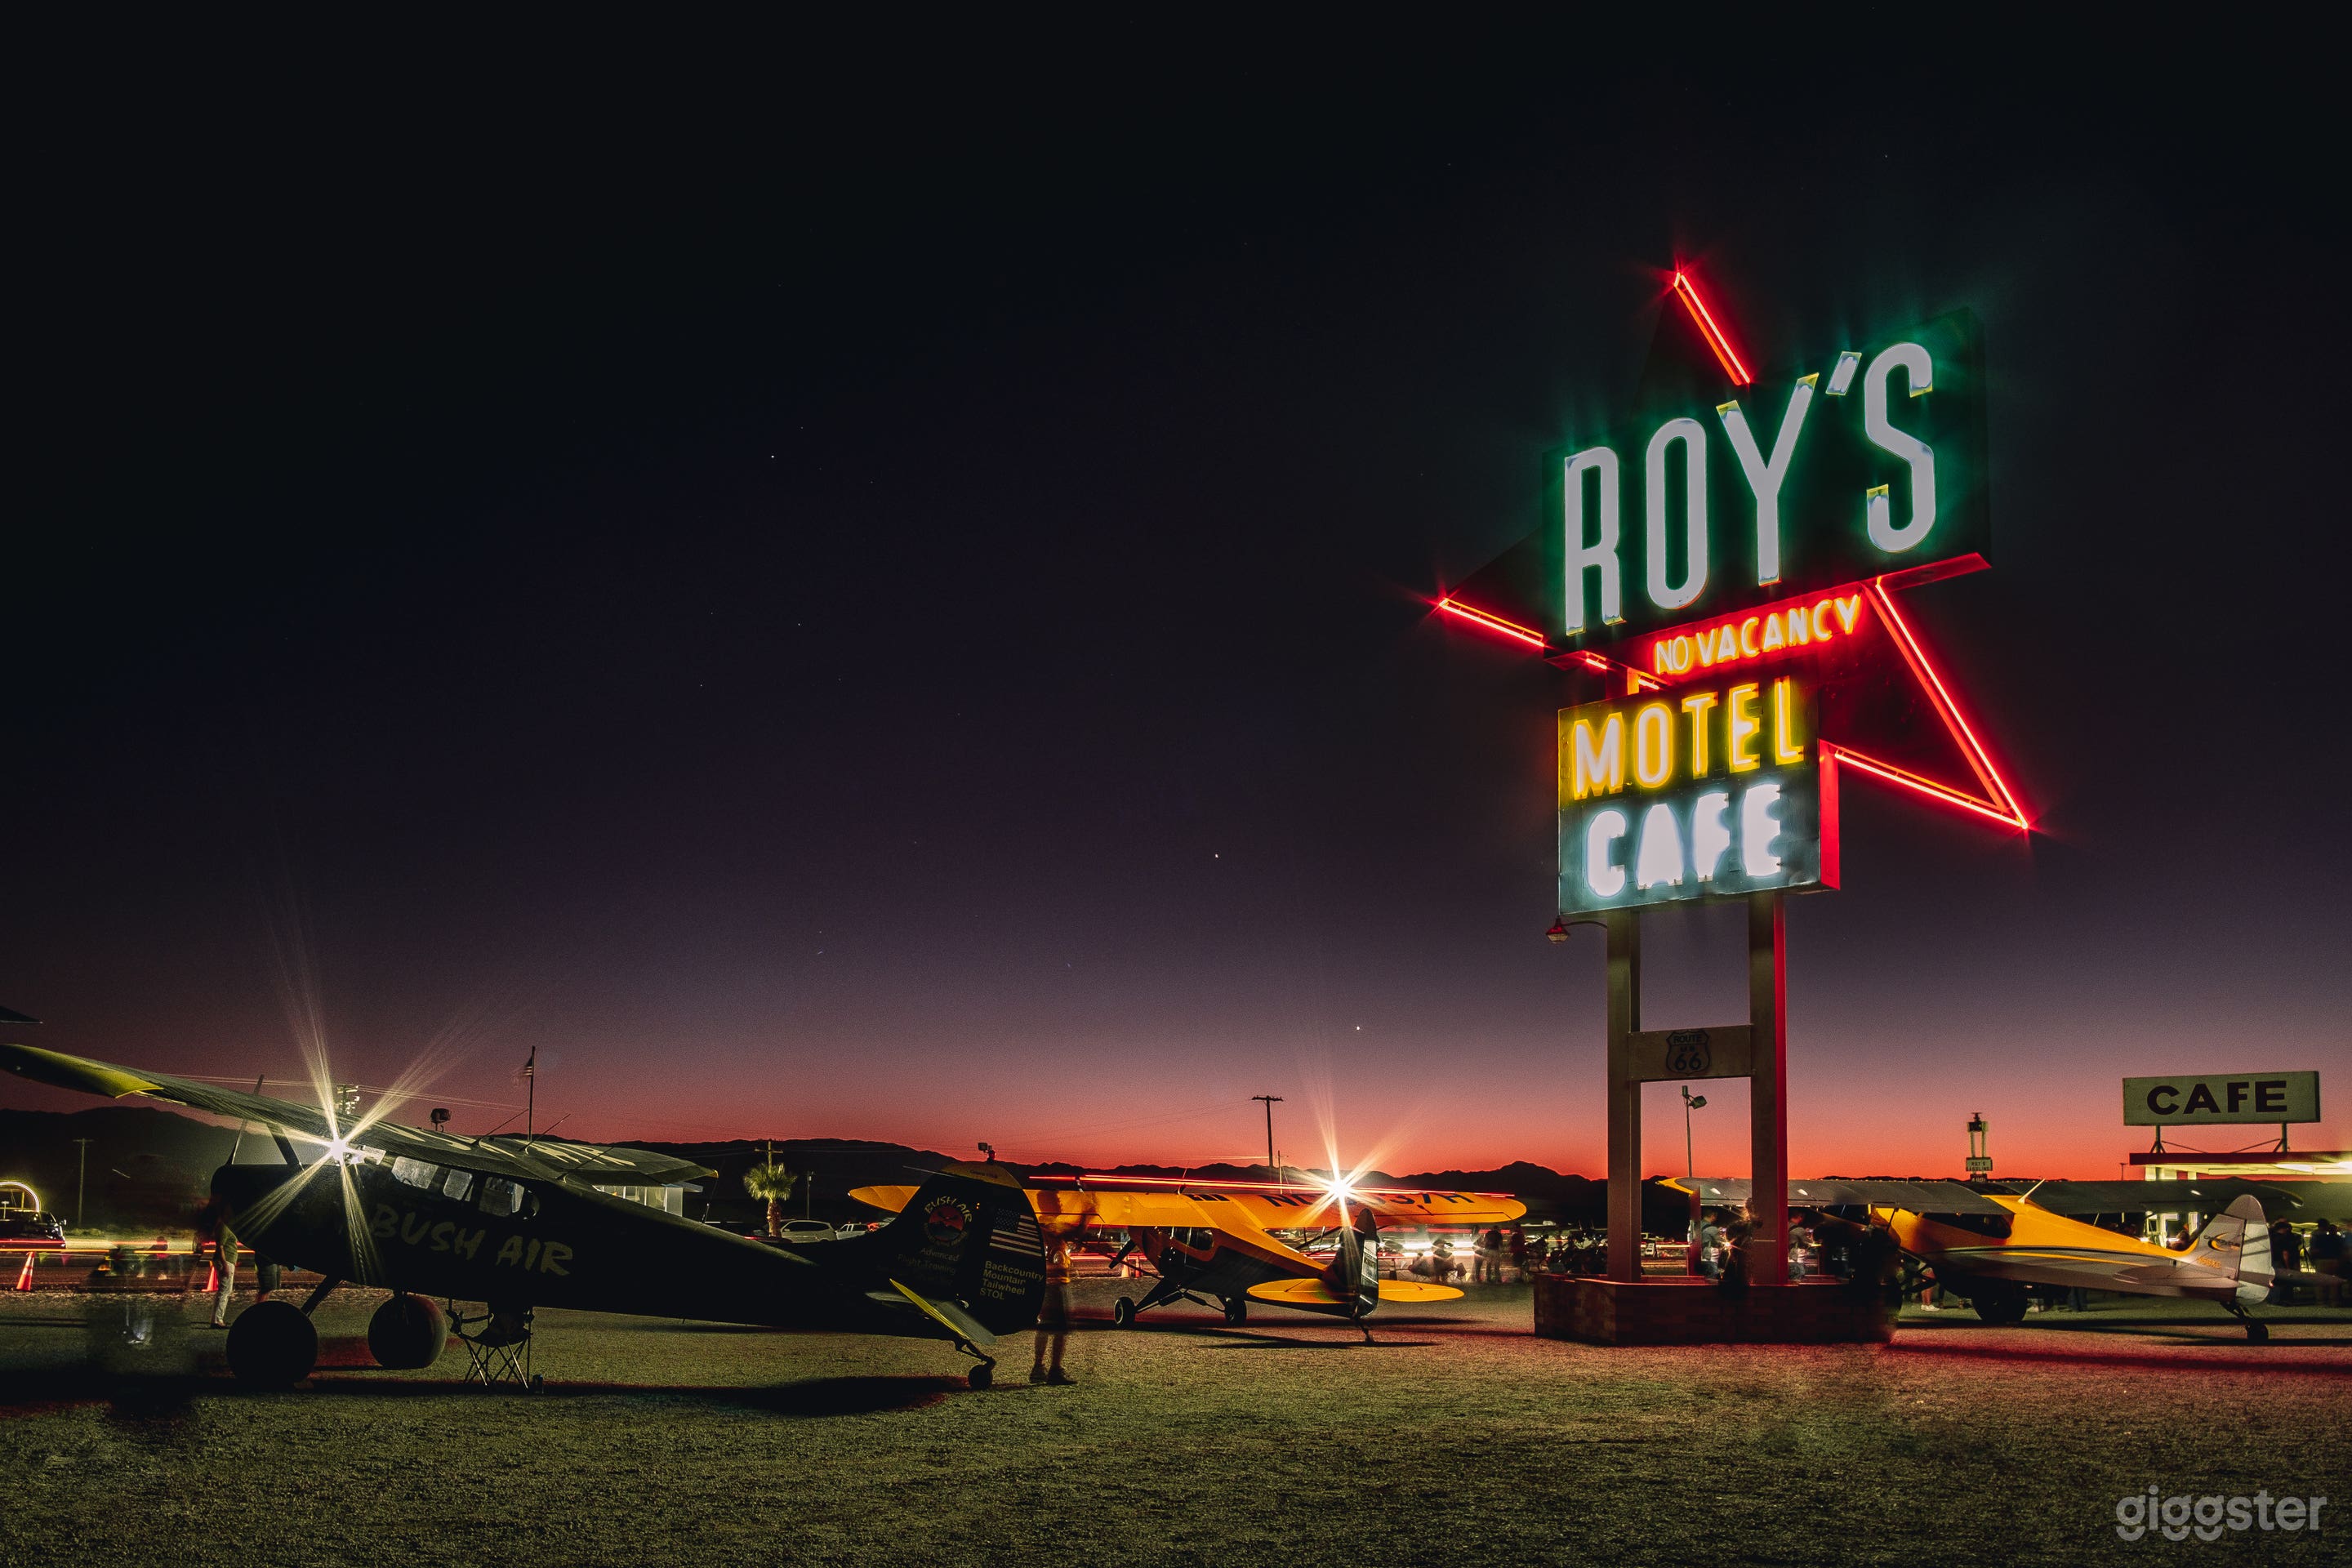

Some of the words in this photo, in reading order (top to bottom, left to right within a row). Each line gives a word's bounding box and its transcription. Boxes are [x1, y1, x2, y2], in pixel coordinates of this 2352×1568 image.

[1564, 342, 1936, 636] ROY'S
[1654, 636, 1692, 675] NO
[1695, 595, 1860, 666] VACANCY
[1572, 675, 1805, 800] MOTEL
[1586, 783, 1782, 898] CAFE
[1673, 1034, 1703, 1044] ROUTE
[1675, 1052, 1701, 1071] 66
[2147, 1081, 2287, 1116] CAFE
[924, 1196, 957, 1214] BUSH
[956, 1202, 973, 1224] AIR
[369, 1203, 486, 1260] BUSH
[496, 1235, 573, 1276] AIR
[920, 1247, 960, 1262] Advanced
[985, 1260, 1044, 1281] Backcountry
[980, 1287, 1005, 1300] STOL
[982, 1278, 1026, 1295] Tailwheel
